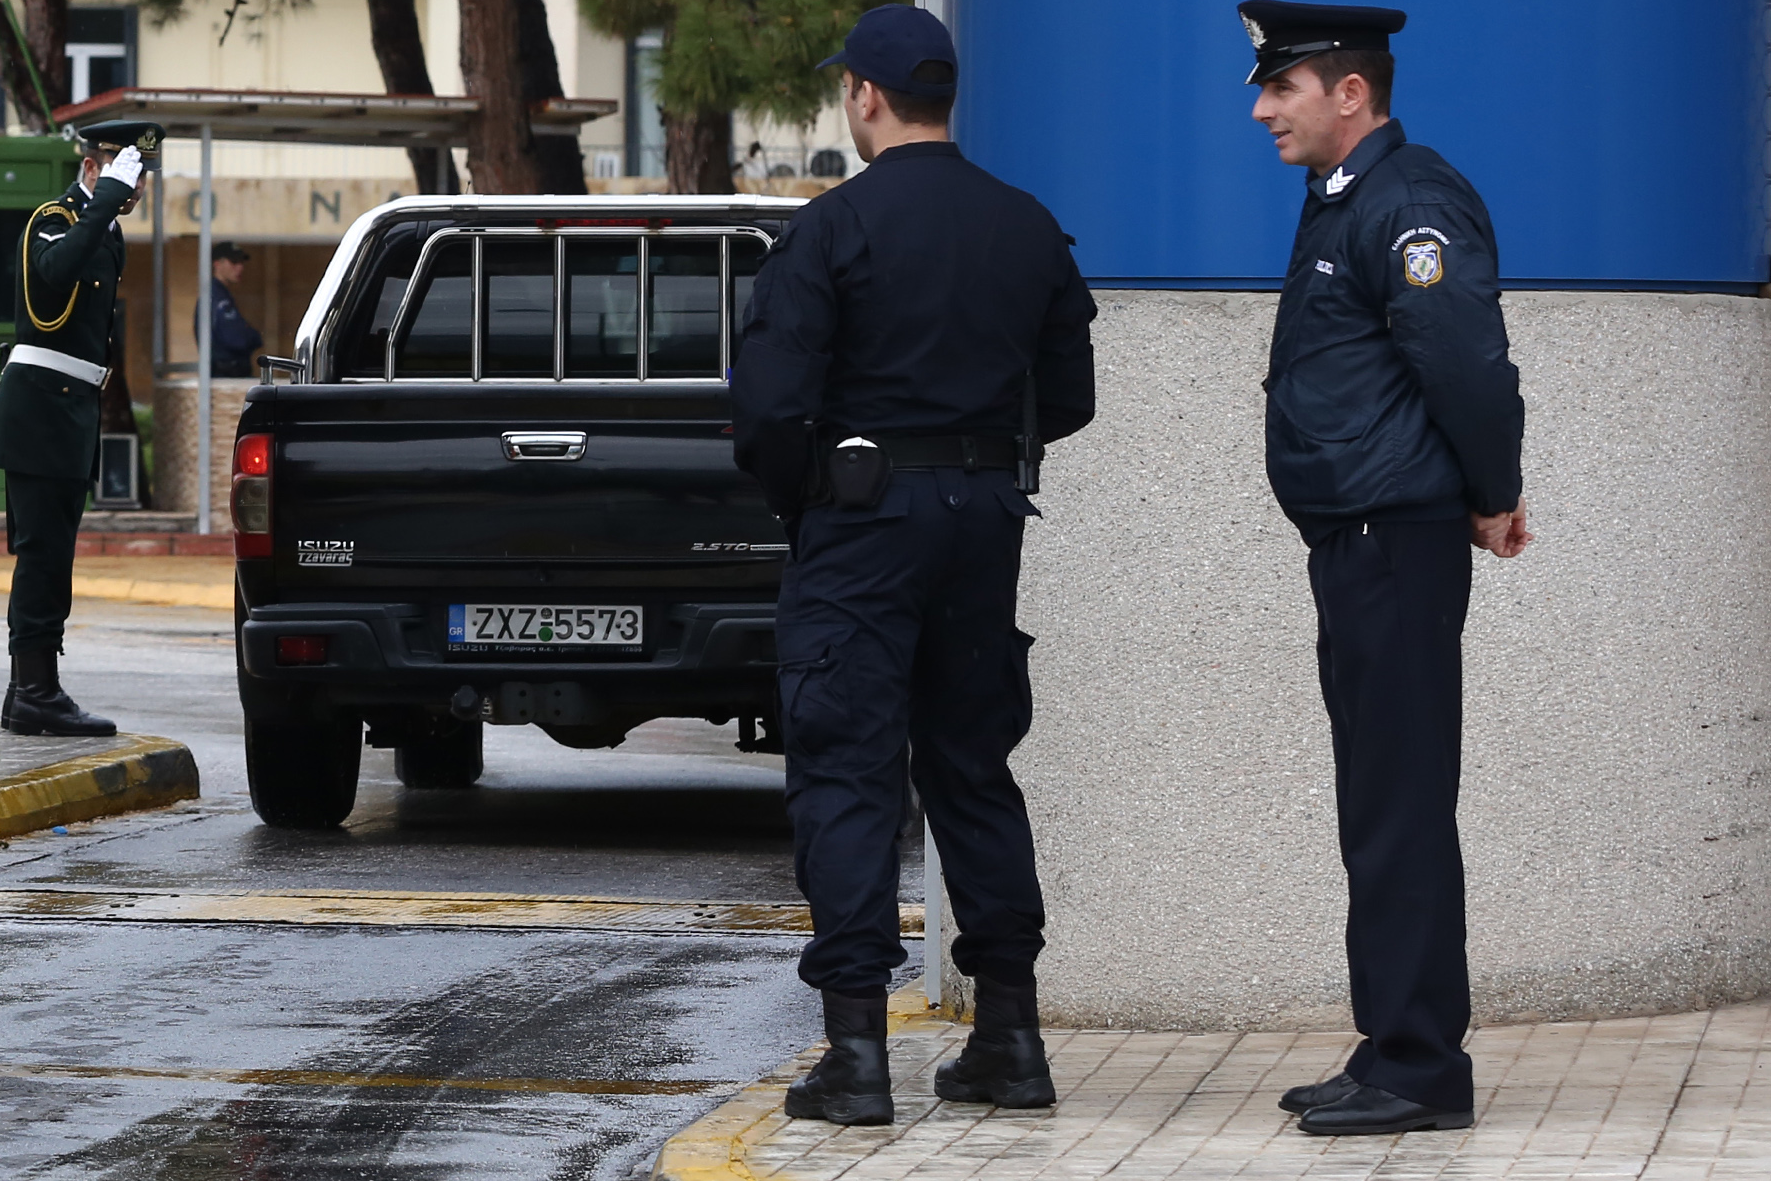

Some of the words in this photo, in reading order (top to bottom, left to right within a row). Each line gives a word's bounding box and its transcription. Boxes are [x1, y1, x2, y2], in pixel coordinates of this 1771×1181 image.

[297, 540, 355, 552] ISUZU
[449, 626, 463, 636] GR
[448, 644, 488, 653] ISUZU
